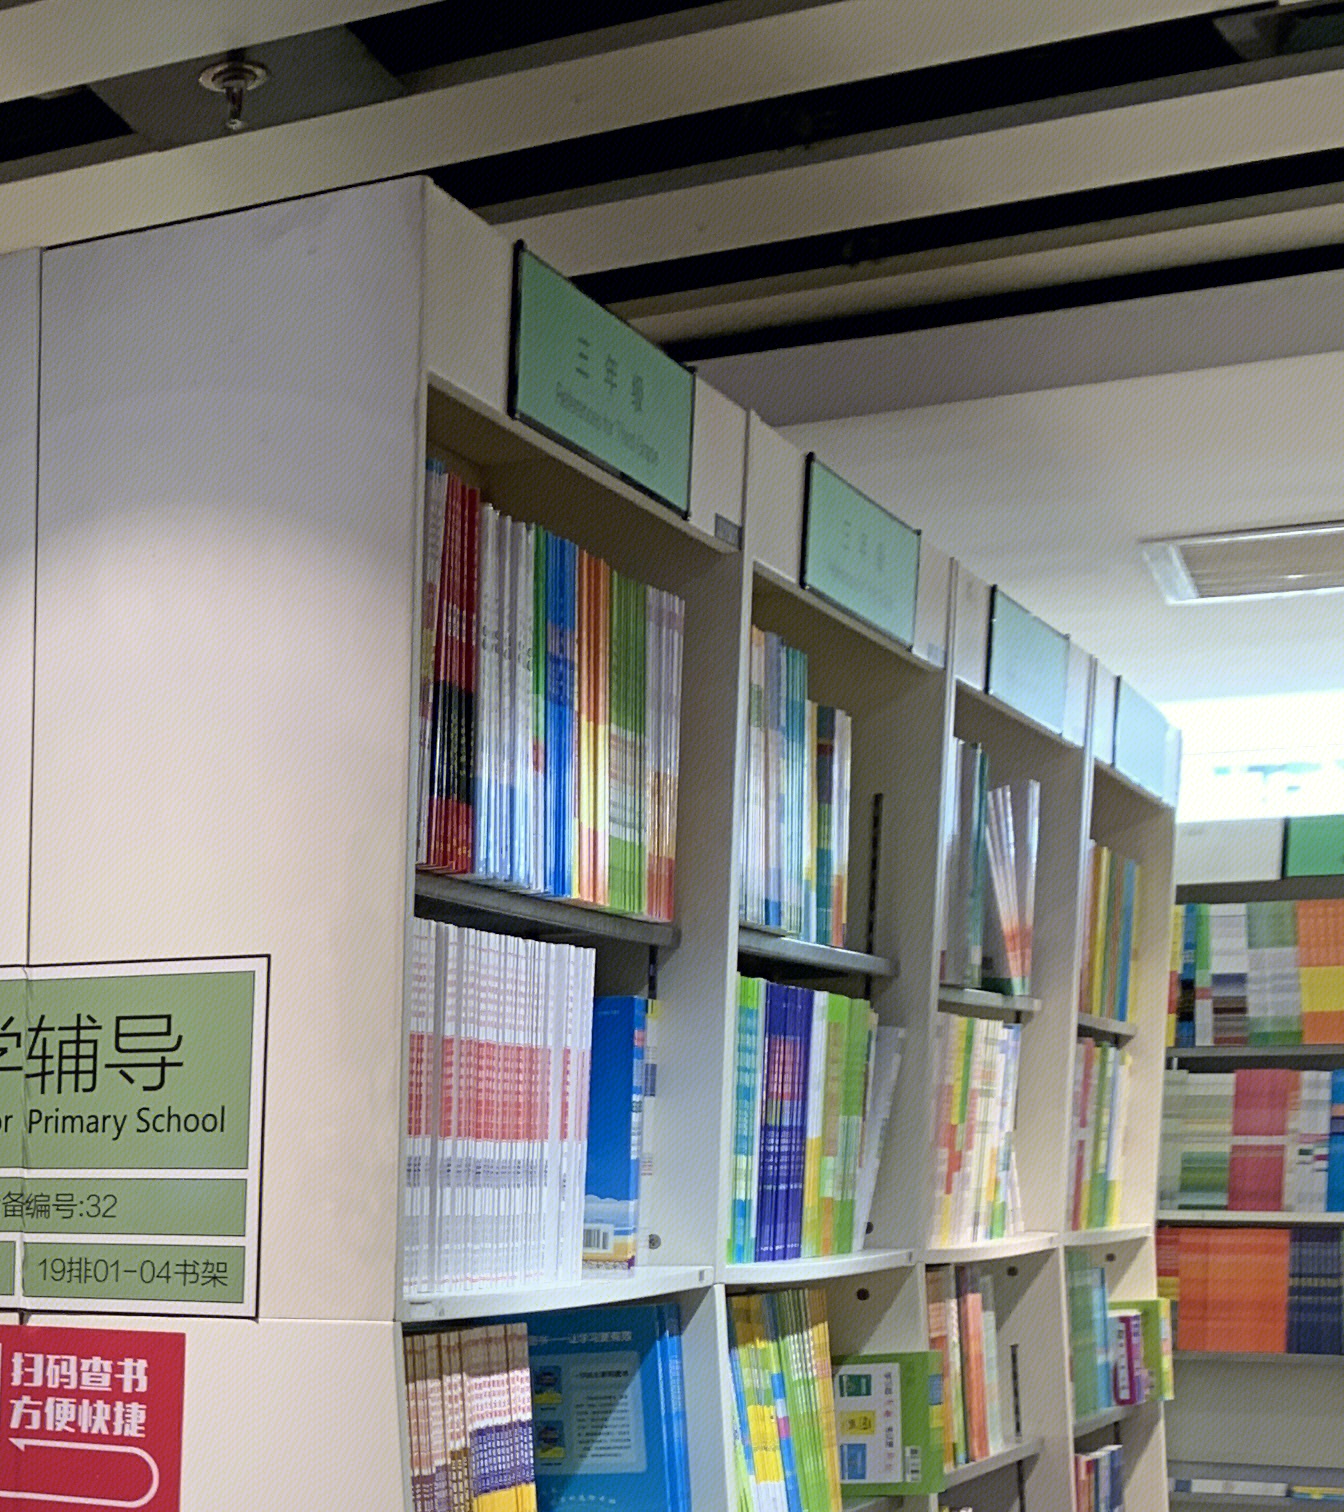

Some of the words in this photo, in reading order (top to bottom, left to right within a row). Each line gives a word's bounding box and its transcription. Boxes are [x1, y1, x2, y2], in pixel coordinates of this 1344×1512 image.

[28, 1108, 127, 1140] Primary
[136, 1105, 226, 1134] School
[38, 1256, 228, 1288] 19排01-04书架
[10, 1352, 149, 1393] 扫码查书
[9, 1395, 147, 1438] 方便快捷
